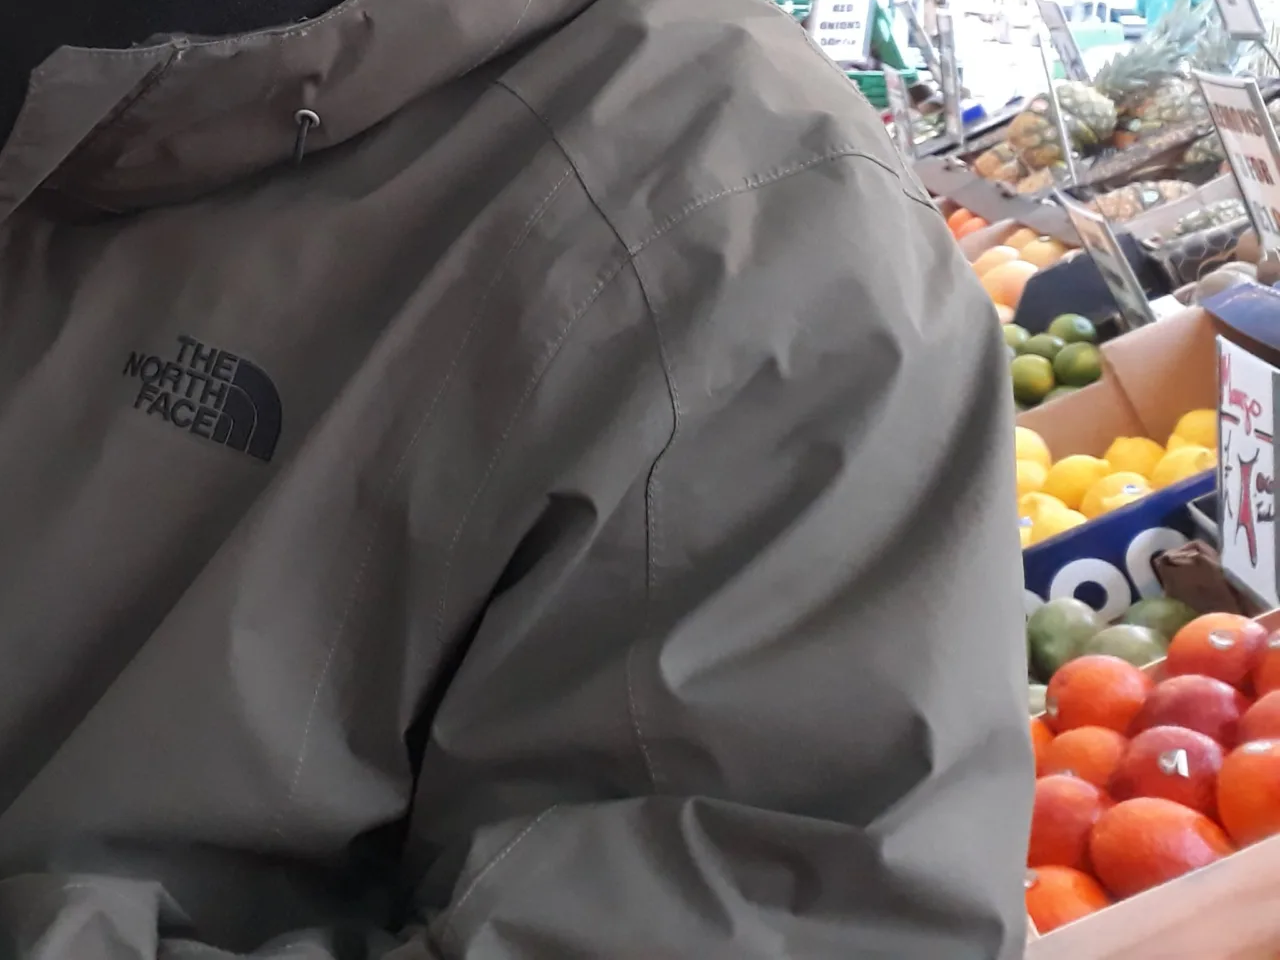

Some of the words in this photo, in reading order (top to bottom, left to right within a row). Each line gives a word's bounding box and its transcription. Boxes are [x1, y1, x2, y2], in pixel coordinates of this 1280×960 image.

[819, 20, 861, 30] ONIONS
[122, 350, 230, 411] NORTH
[177, 334, 240, 383] THE
[133, 383, 221, 440] FACE
